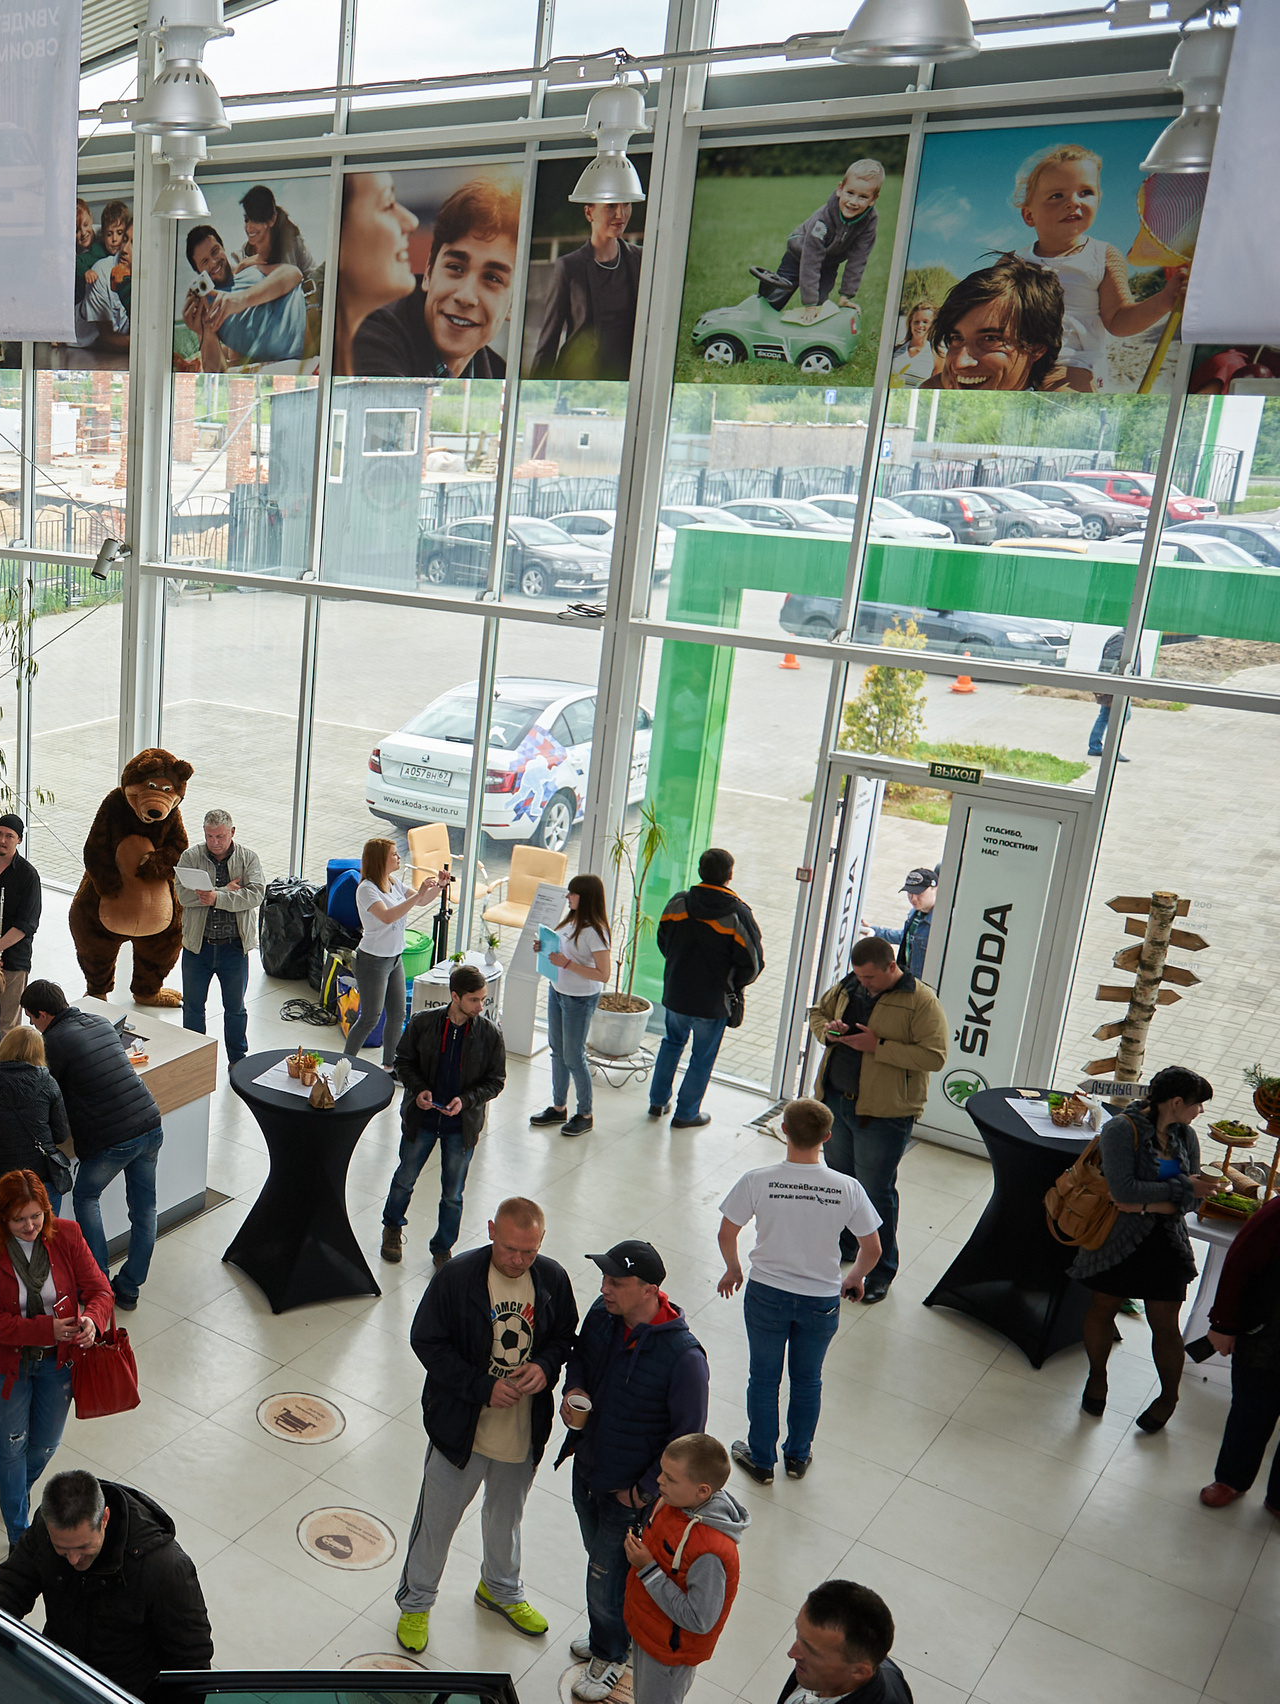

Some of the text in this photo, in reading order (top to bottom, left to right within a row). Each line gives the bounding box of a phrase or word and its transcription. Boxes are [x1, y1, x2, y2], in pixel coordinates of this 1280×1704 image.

[933, 765, 977, 782] ВЫХОД
[382, 795, 460, 816] www.skoda-s-auto.ru
[984, 825, 1023, 838] СПАСИБО,
[983, 836, 1039, 852] ЧТО ПОСЕТИЛИ
[981, 848, 1000, 857] НАС!
[953, 903, 1014, 1058] ŠKODA
[768, 1181, 842, 1195] #ХоккейВкаждом
